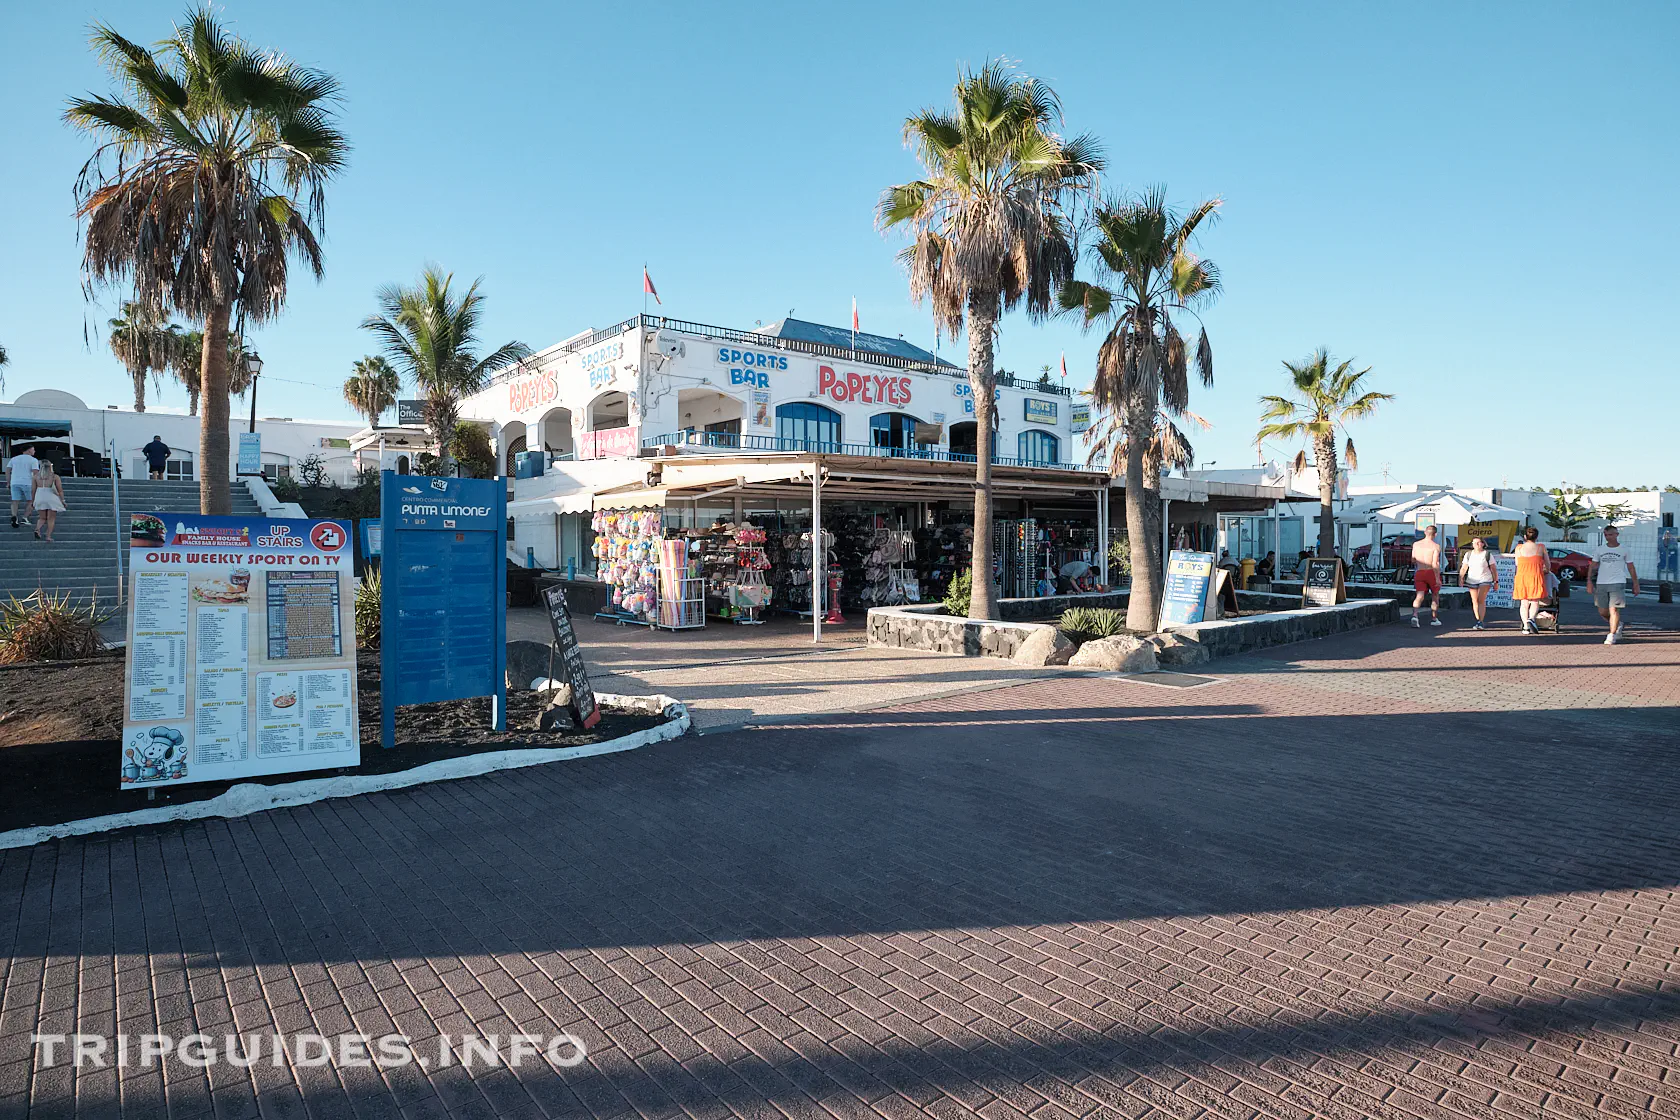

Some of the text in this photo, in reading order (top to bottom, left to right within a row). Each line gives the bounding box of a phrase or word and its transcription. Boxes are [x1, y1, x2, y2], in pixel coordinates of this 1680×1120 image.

[581, 342, 618, 369] SPORTS
[719, 348, 788, 370] SPORTS
[589, 366, 611, 388] BAR
[730, 368, 770, 389] BAR
[819, 365, 912, 405] POPEYES
[509, 370, 555, 412] POPEYES
[955, 384, 1001, 400] SPS
[401, 504, 491, 517] PUNTA LIMONES
[270, 526, 290, 536] UP
[1467, 528, 1493, 536] Cajero
[258, 536, 303, 547] STAIRS
[146, 552, 182, 564] OUR
[186, 553, 244, 565] WEEKLY
[248, 554, 295, 565] SPORT
[323, 555, 341, 566] TV
